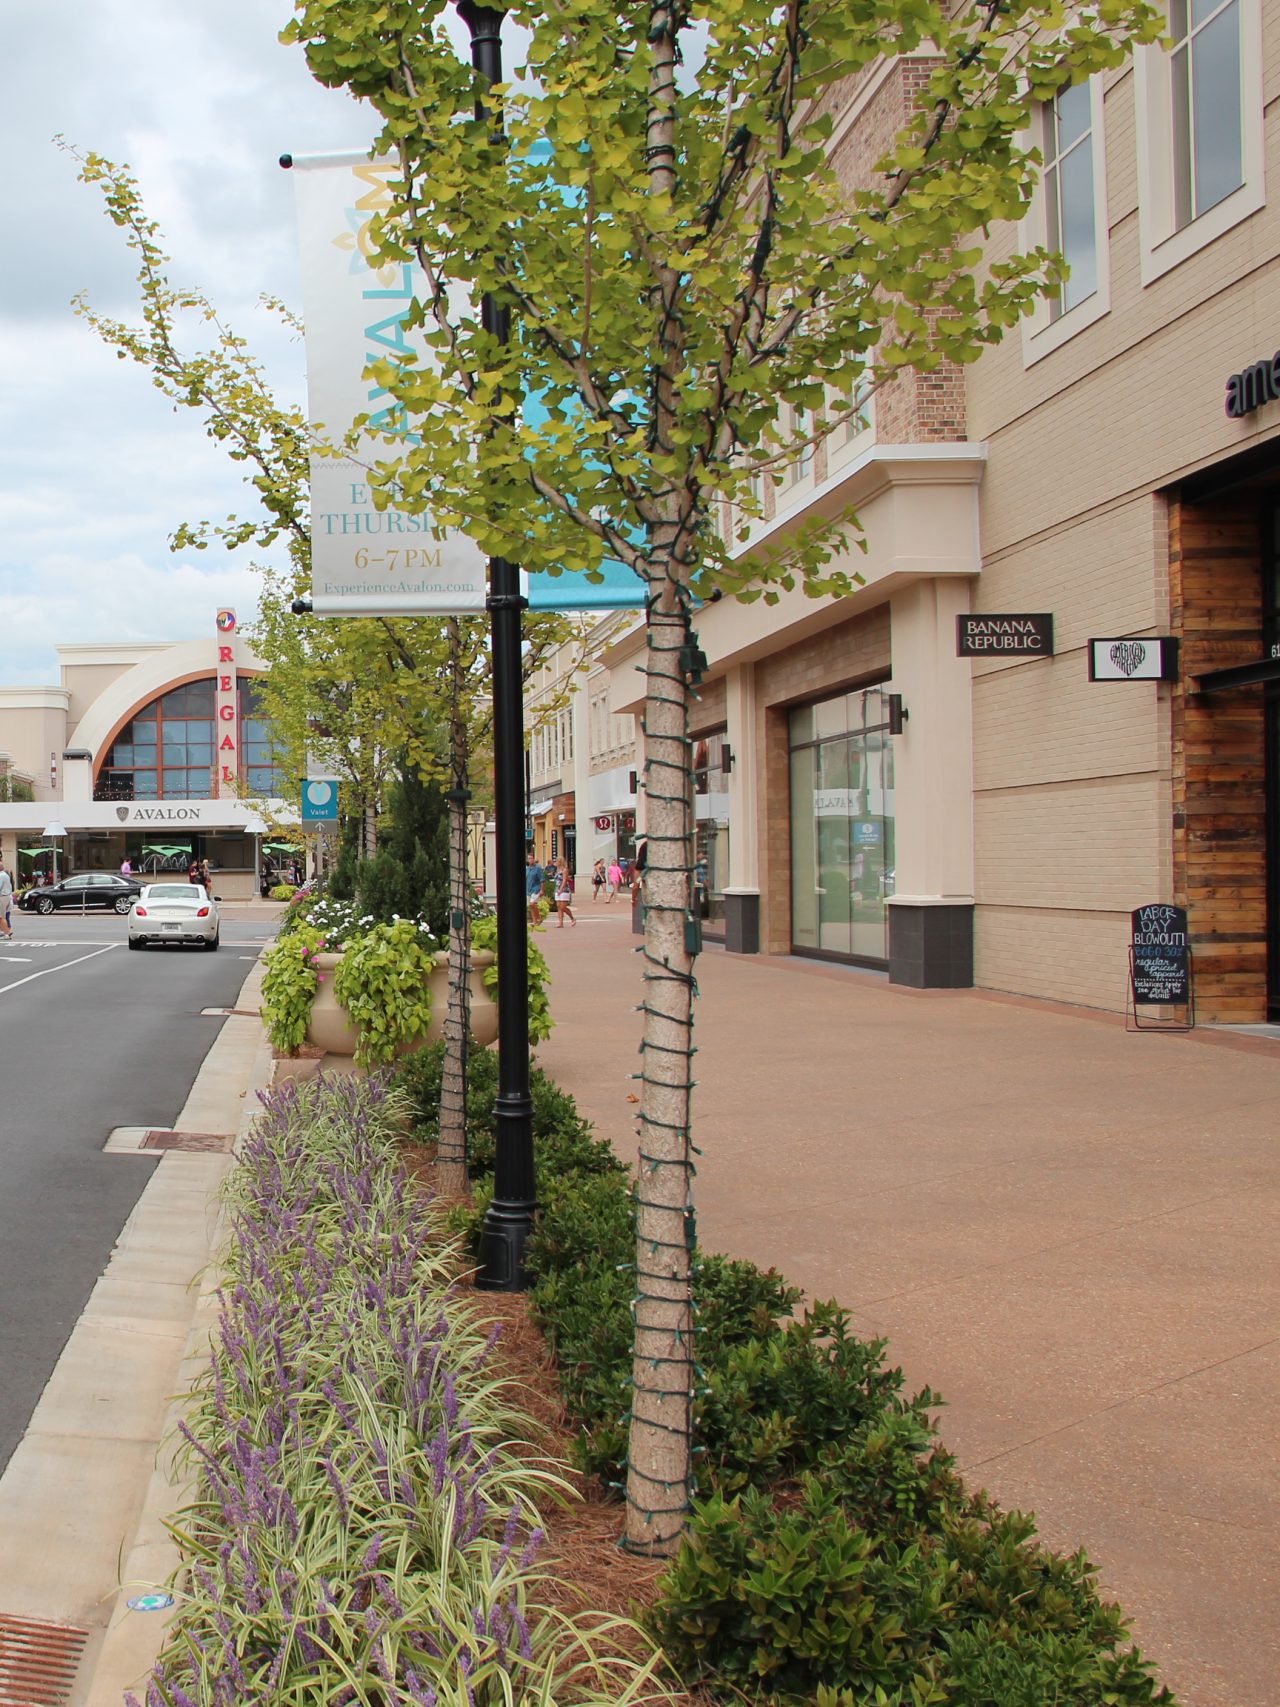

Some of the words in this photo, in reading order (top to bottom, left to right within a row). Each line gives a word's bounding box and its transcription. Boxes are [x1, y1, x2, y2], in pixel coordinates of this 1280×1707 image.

[403, 548, 442, 568] PM
[324, 581, 474, 596] ExperienceAvalon.com
[967, 621, 1035, 634] BANANA
[963, 635, 1041, 649] REPUBLIC
[218, 646, 235, 781] REGAL
[133, 808, 201, 820] AVALON
[1140, 906, 1176, 920] LABOR
[1141, 920, 1171, 932] DAY
[1134, 932, 1185, 946] BLOWOUT!
[1136, 957, 1169, 971] regular
